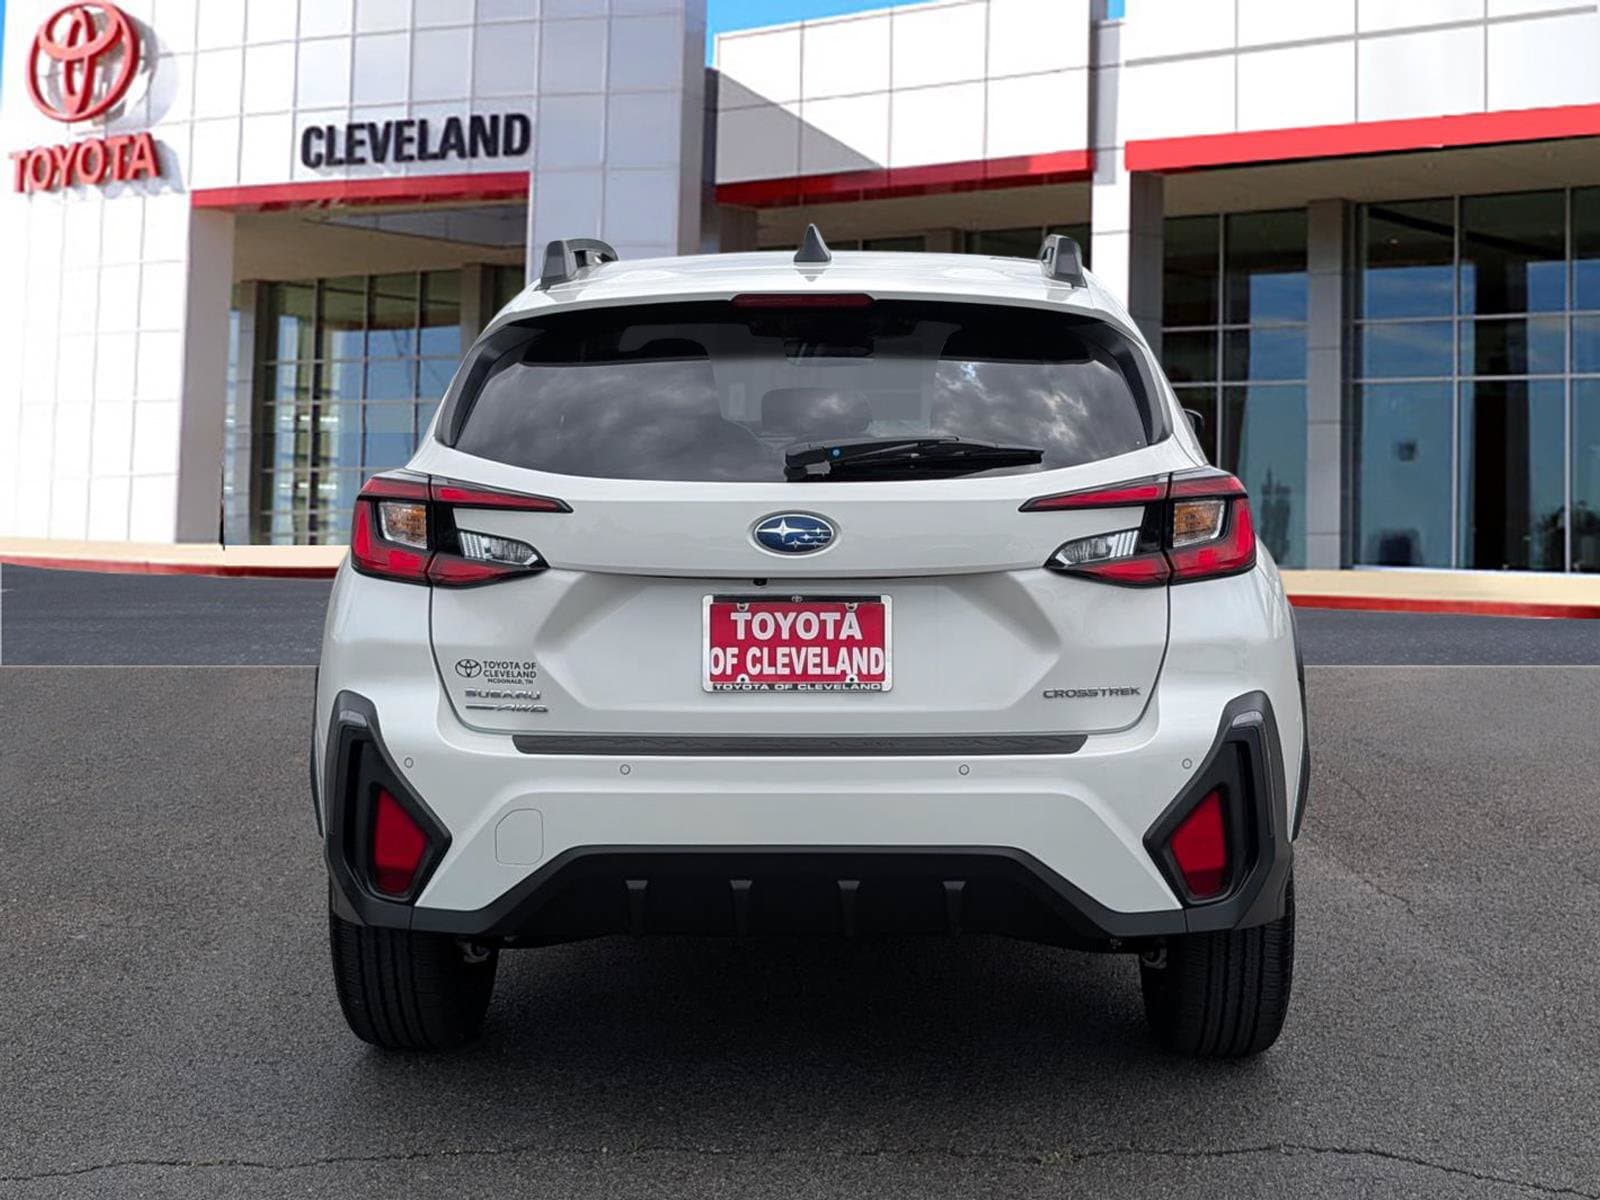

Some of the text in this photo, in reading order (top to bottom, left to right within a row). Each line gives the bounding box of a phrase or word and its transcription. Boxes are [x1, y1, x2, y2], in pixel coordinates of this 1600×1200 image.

[300, 112, 532, 170] CLEVELAND
[9, 131, 161, 193] TOYOTA
[730, 612, 863, 640] TOYOTA
[483, 661, 537, 670] TOYOTA OF
[711, 647, 885, 675] OF CLEVELAND
[483, 670, 537, 679] CLEVELAND
[715, 683, 882, 691] TOYOTA OF CLEVELAND
[1043, 687, 1141, 699] CROSSTREK
[465, 688, 541, 700] SUBARU
